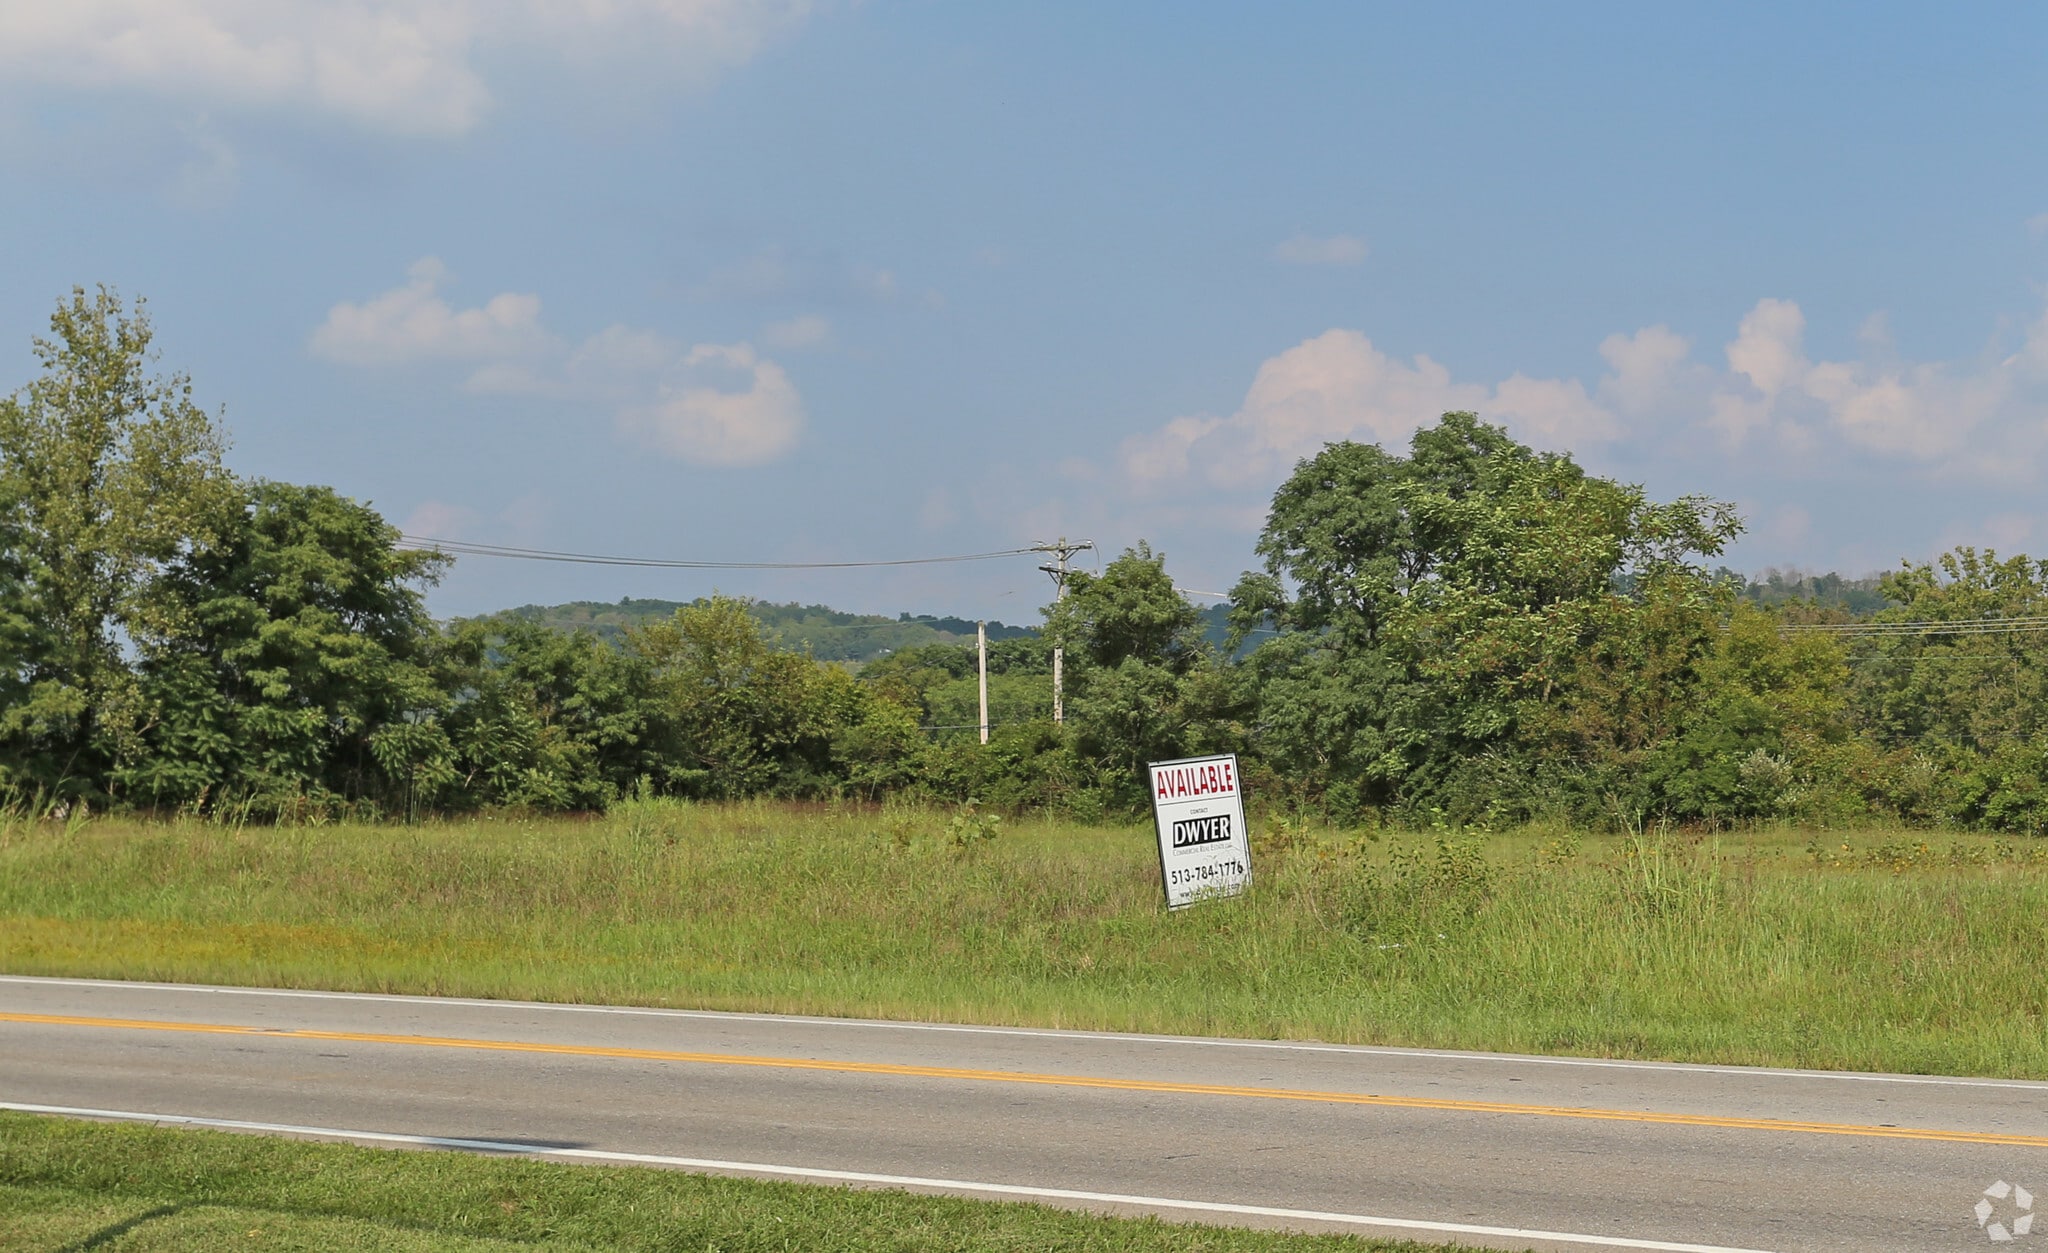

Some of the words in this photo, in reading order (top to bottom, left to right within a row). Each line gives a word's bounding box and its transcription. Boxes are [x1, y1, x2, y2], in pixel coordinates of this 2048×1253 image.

[1157, 764, 1233, 799] AVAILABLE
[1174, 817, 1230, 845] DWYER
[1171, 861, 1244, 884] 513-784-1776
